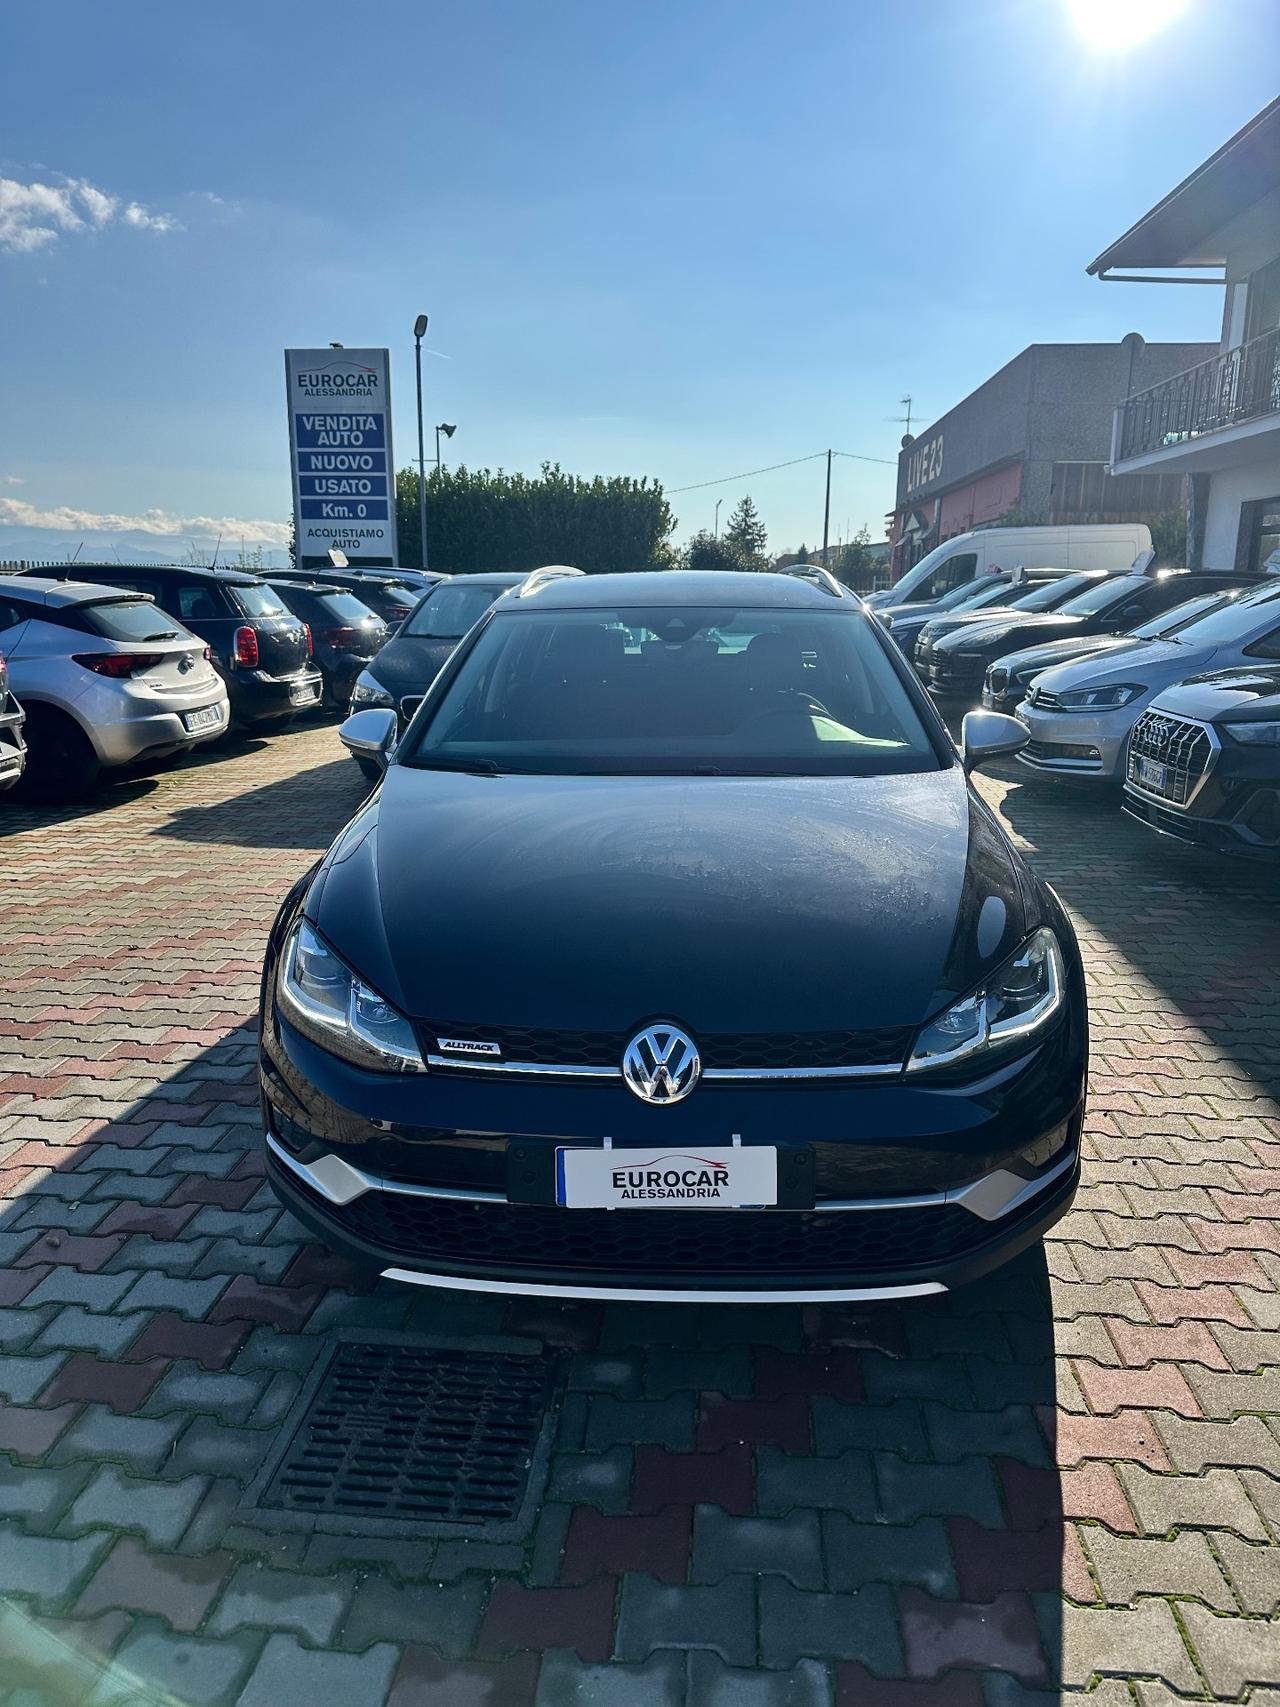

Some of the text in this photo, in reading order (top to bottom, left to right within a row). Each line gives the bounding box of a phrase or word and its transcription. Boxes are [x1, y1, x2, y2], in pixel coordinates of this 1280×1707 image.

[298, 374, 378, 388] EUROCAR
[304, 388, 373, 397] ALESSANDRIA
[302, 416, 377, 430] VENDITA
[317, 431, 364, 446] AUTO
[310, 455, 373, 470] NUOVO
[315, 479, 372, 494] USATO
[322, 503, 367, 518] Km. 0
[307, 528, 384, 540] ACQUISTIAMO
[331, 539, 361, 549] AUTO
[444, 1041, 494, 1051] ALLTRACK
[613, 1170, 729, 1188] EUROCAR
[621, 1188, 721, 1199] ALESSANDRIA
